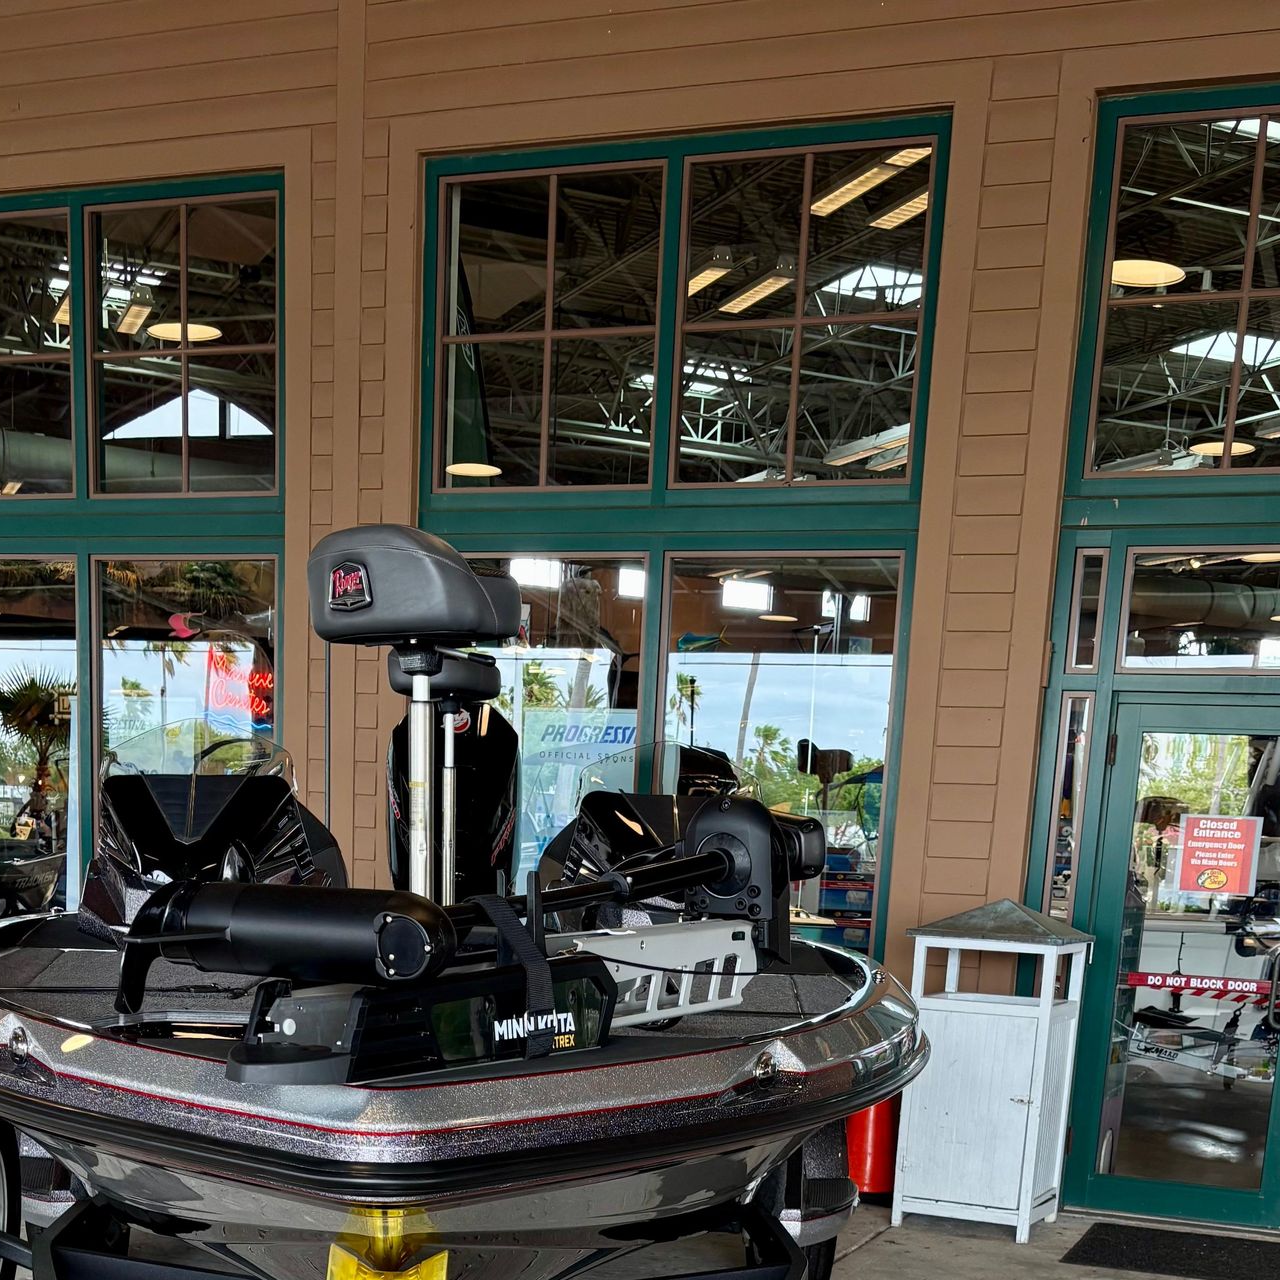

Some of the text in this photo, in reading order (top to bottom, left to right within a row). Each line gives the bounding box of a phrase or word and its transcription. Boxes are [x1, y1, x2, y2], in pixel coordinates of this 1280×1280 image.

[332, 569, 363, 598] Ranger
[541, 725, 637, 745] PROGRESSI
[539, 751, 634, 764] OFFICIAL SPONS
[1199, 819, 1238, 830] Closed
[1193, 828, 1242, 839] Entrance
[1187, 840, 1246, 850] Emergency Door
[1195, 851, 1235, 860] Please Enter
[1218, 860, 1238, 868] Doors
[1147, 975, 1258, 992] DO NOT BLOCK DOOR
[493, 1008, 576, 1041] MINN KOTA
[552, 1034, 576, 1049] TREX
